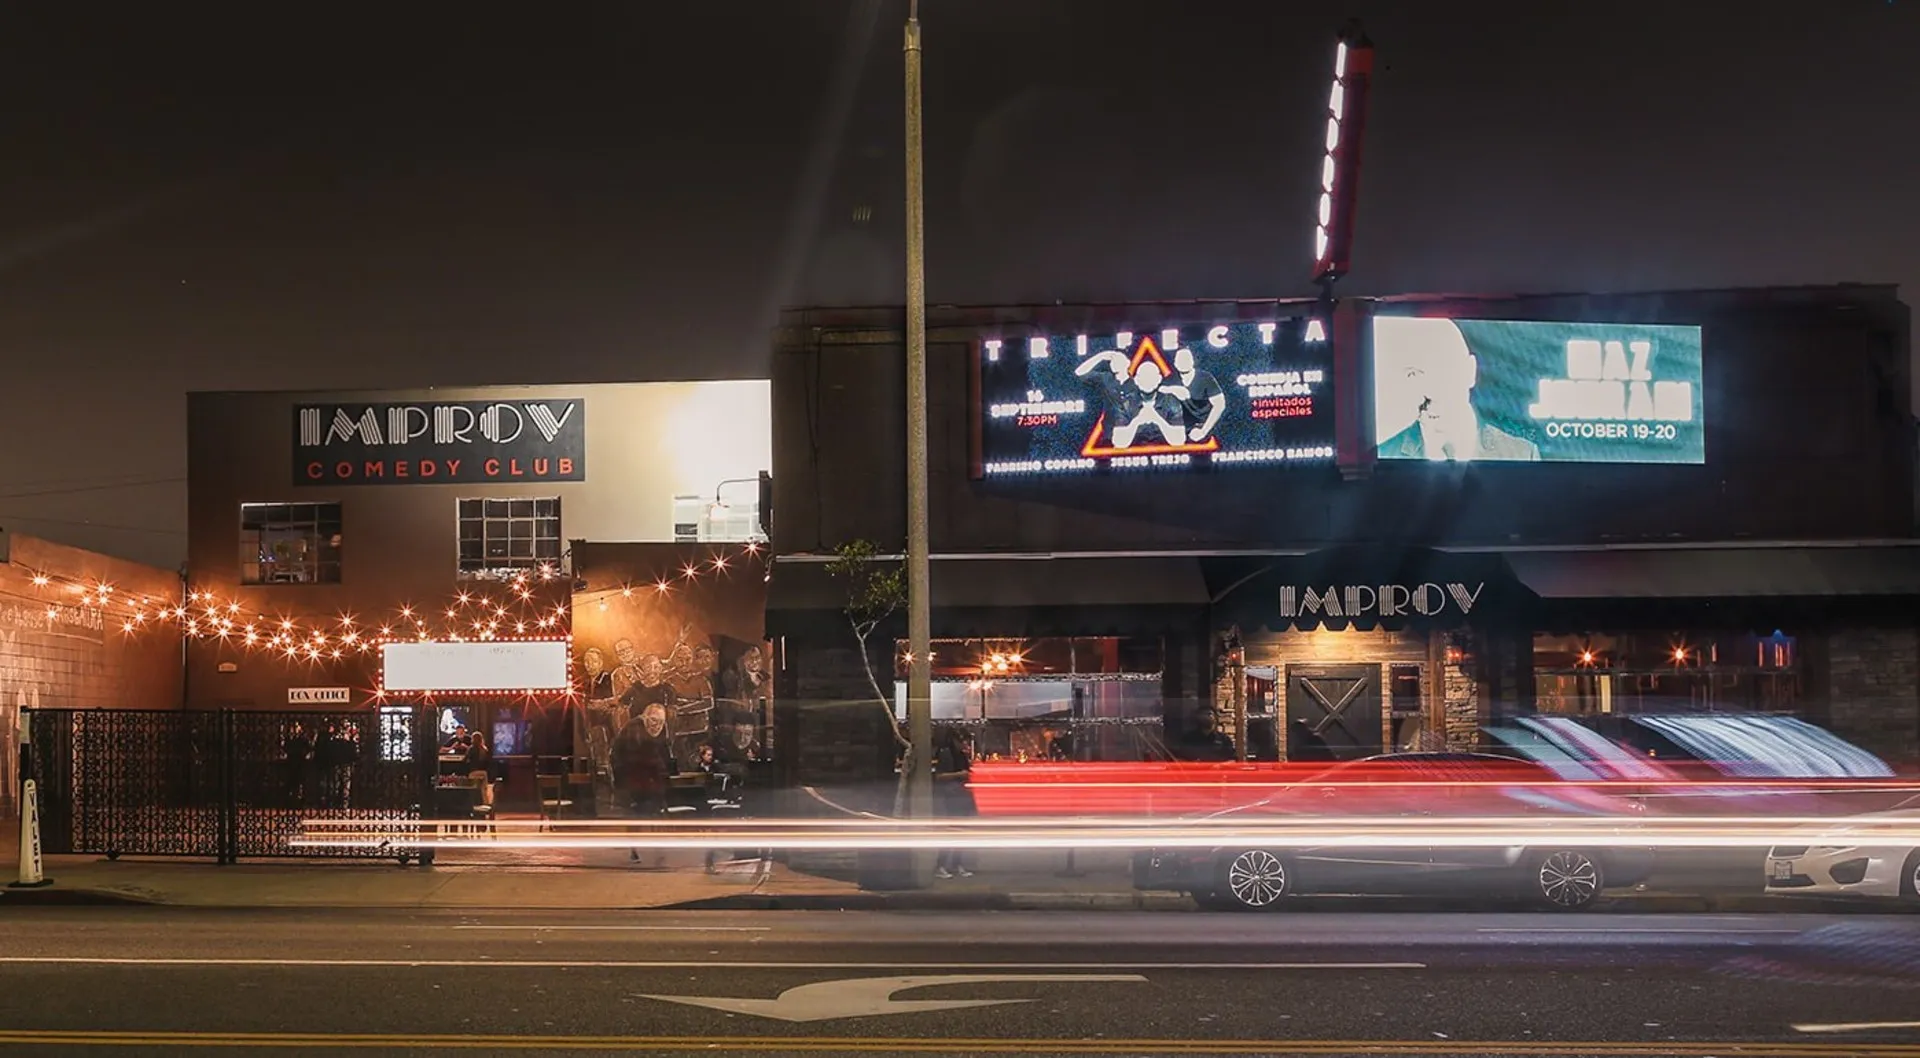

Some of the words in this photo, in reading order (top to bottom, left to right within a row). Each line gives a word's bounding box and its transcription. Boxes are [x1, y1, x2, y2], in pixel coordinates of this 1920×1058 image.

[984, 320, 1327, 361] TRIFECTA
[1567, 340, 1652, 381] AZ
[300, 403, 574, 446] IMPROV
[1017, 415, 1057, 426] 7:30PM
[1252, 407, 1312, 419] especiales
[1546, 422, 1628, 438] OCTOBER
[1632, 424, 1676, 439] 19-20
[307, 459, 461, 478] COMEDY
[484, 458, 574, 475] CLUB
[1280, 582, 1484, 617] IMPROV
[29, 792, 40, 873] VALET
